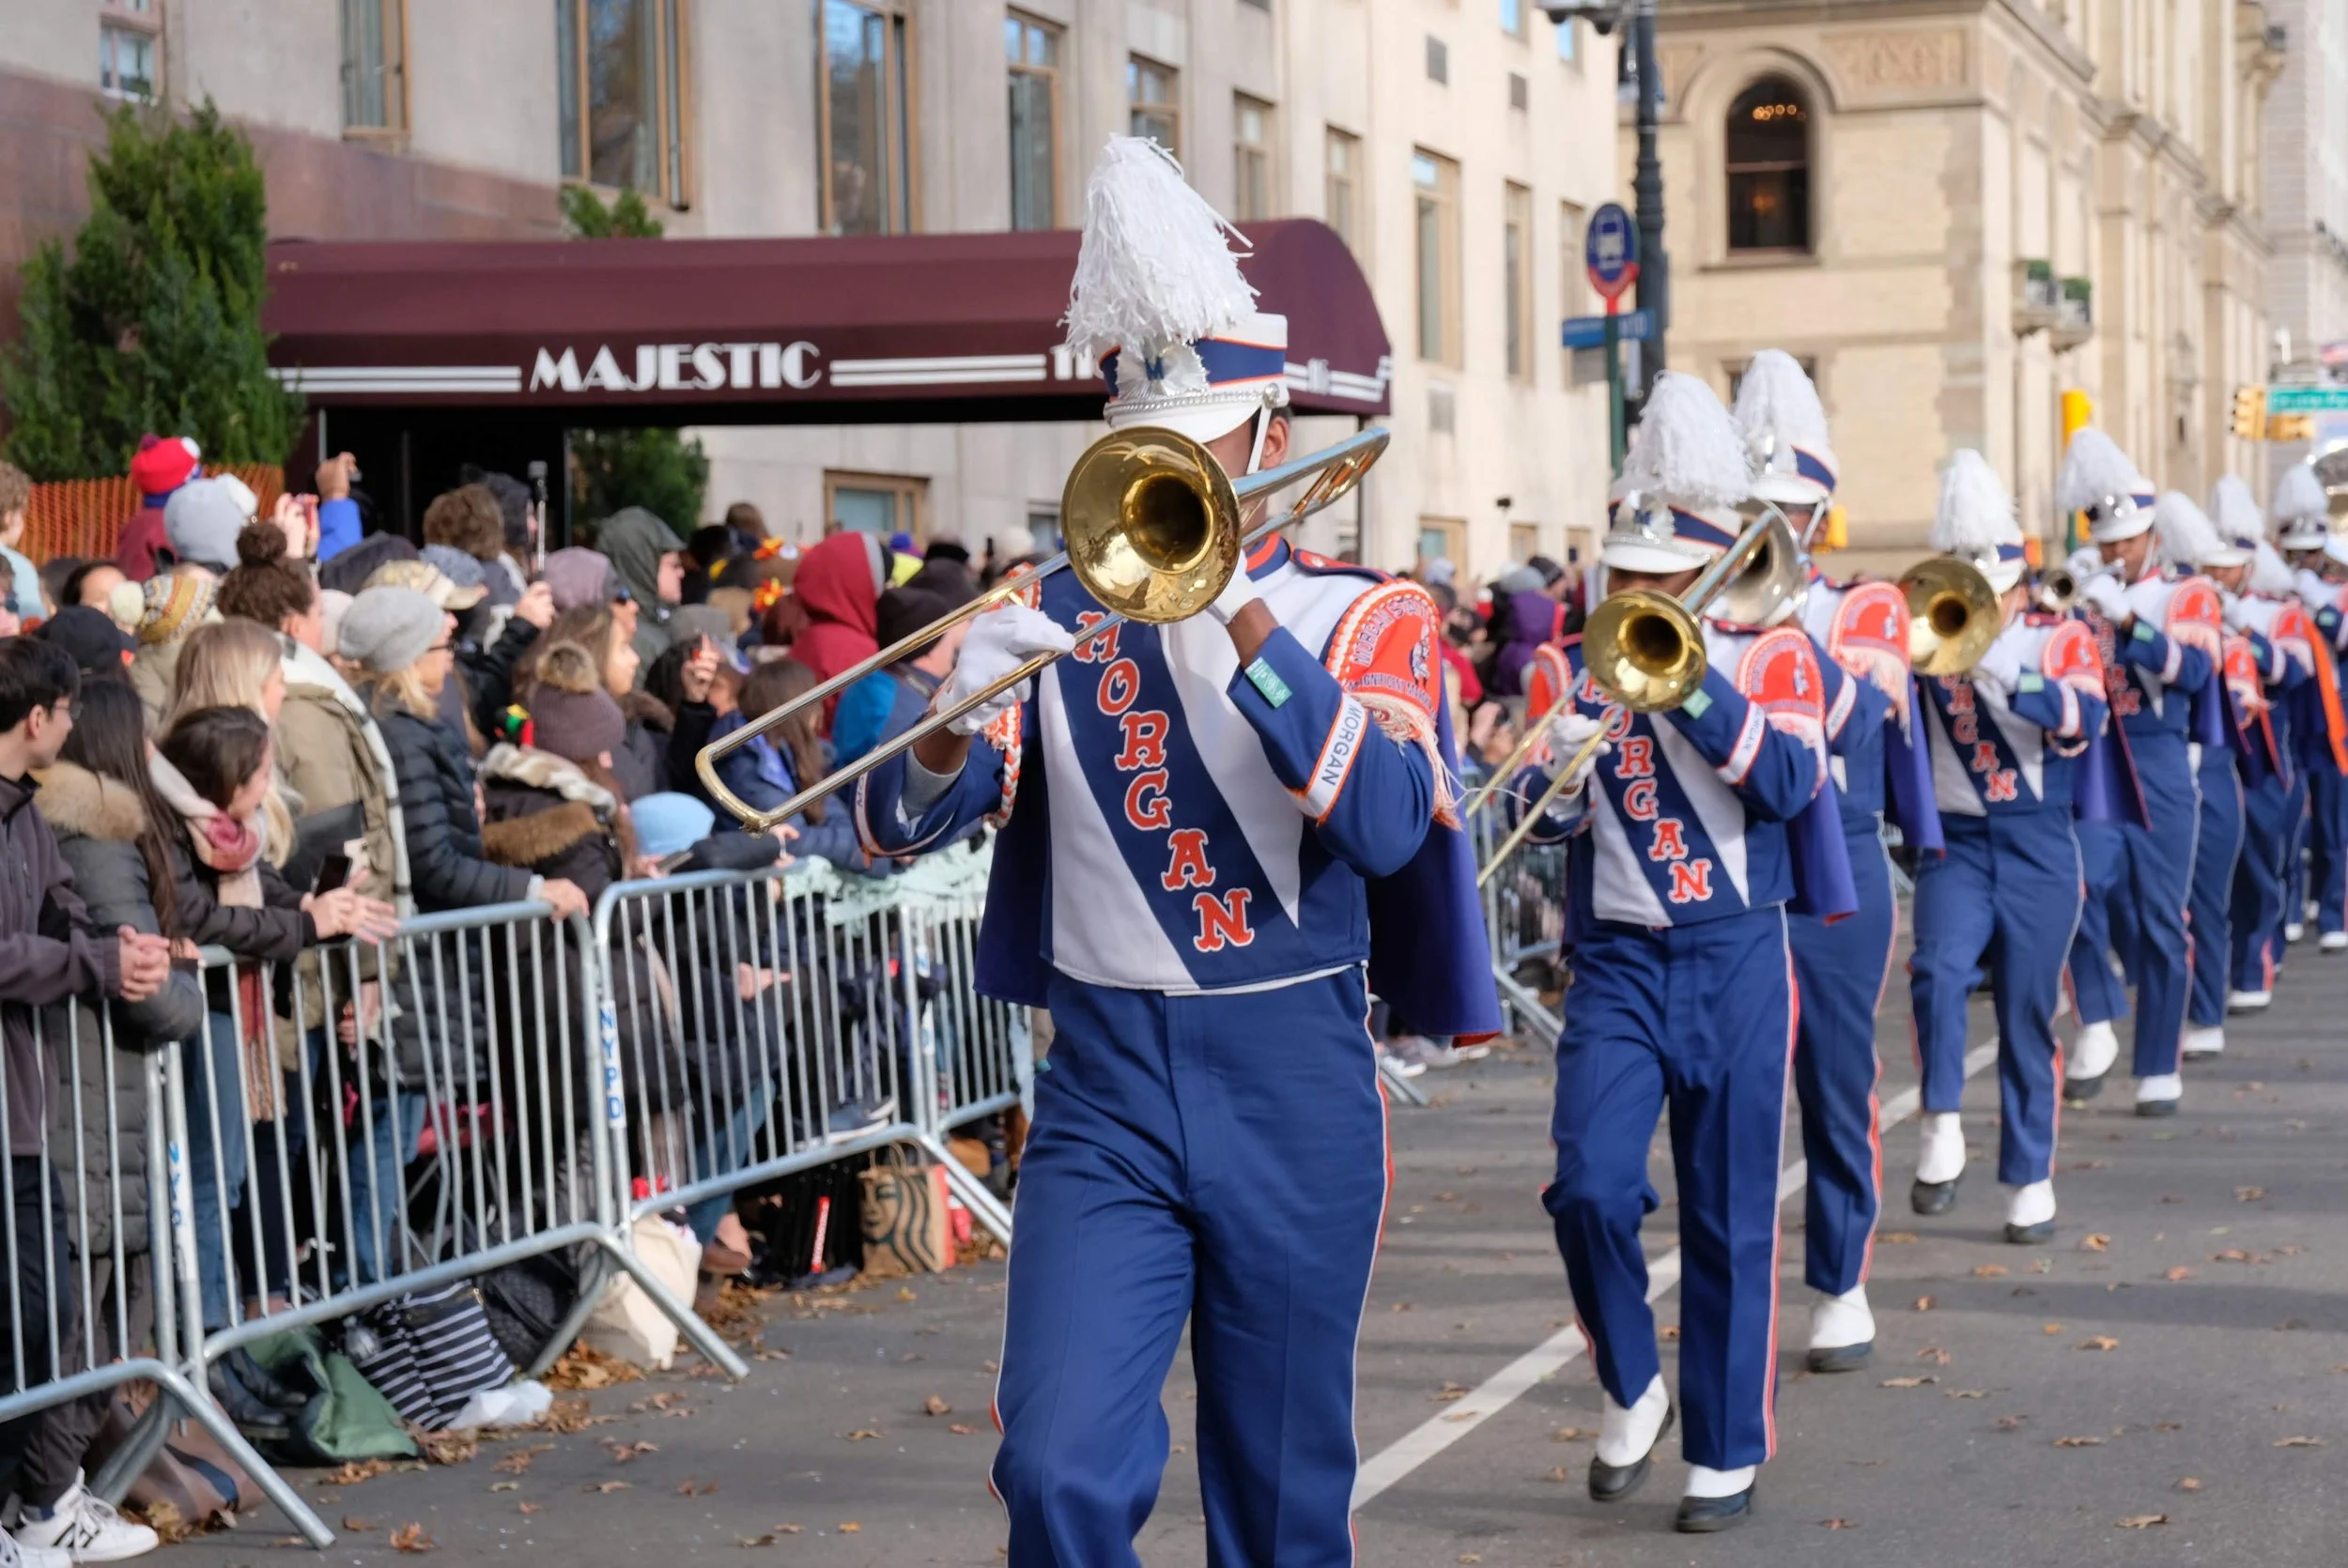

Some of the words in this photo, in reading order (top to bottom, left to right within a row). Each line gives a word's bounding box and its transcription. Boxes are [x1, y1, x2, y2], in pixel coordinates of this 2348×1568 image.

[529, 341, 823, 392] MAJESTIC
[1072, 610, 1255, 954] MORGAN
[1321, 704, 1363, 787] MORGAN
[599, 1005, 624, 1121] NYPD
